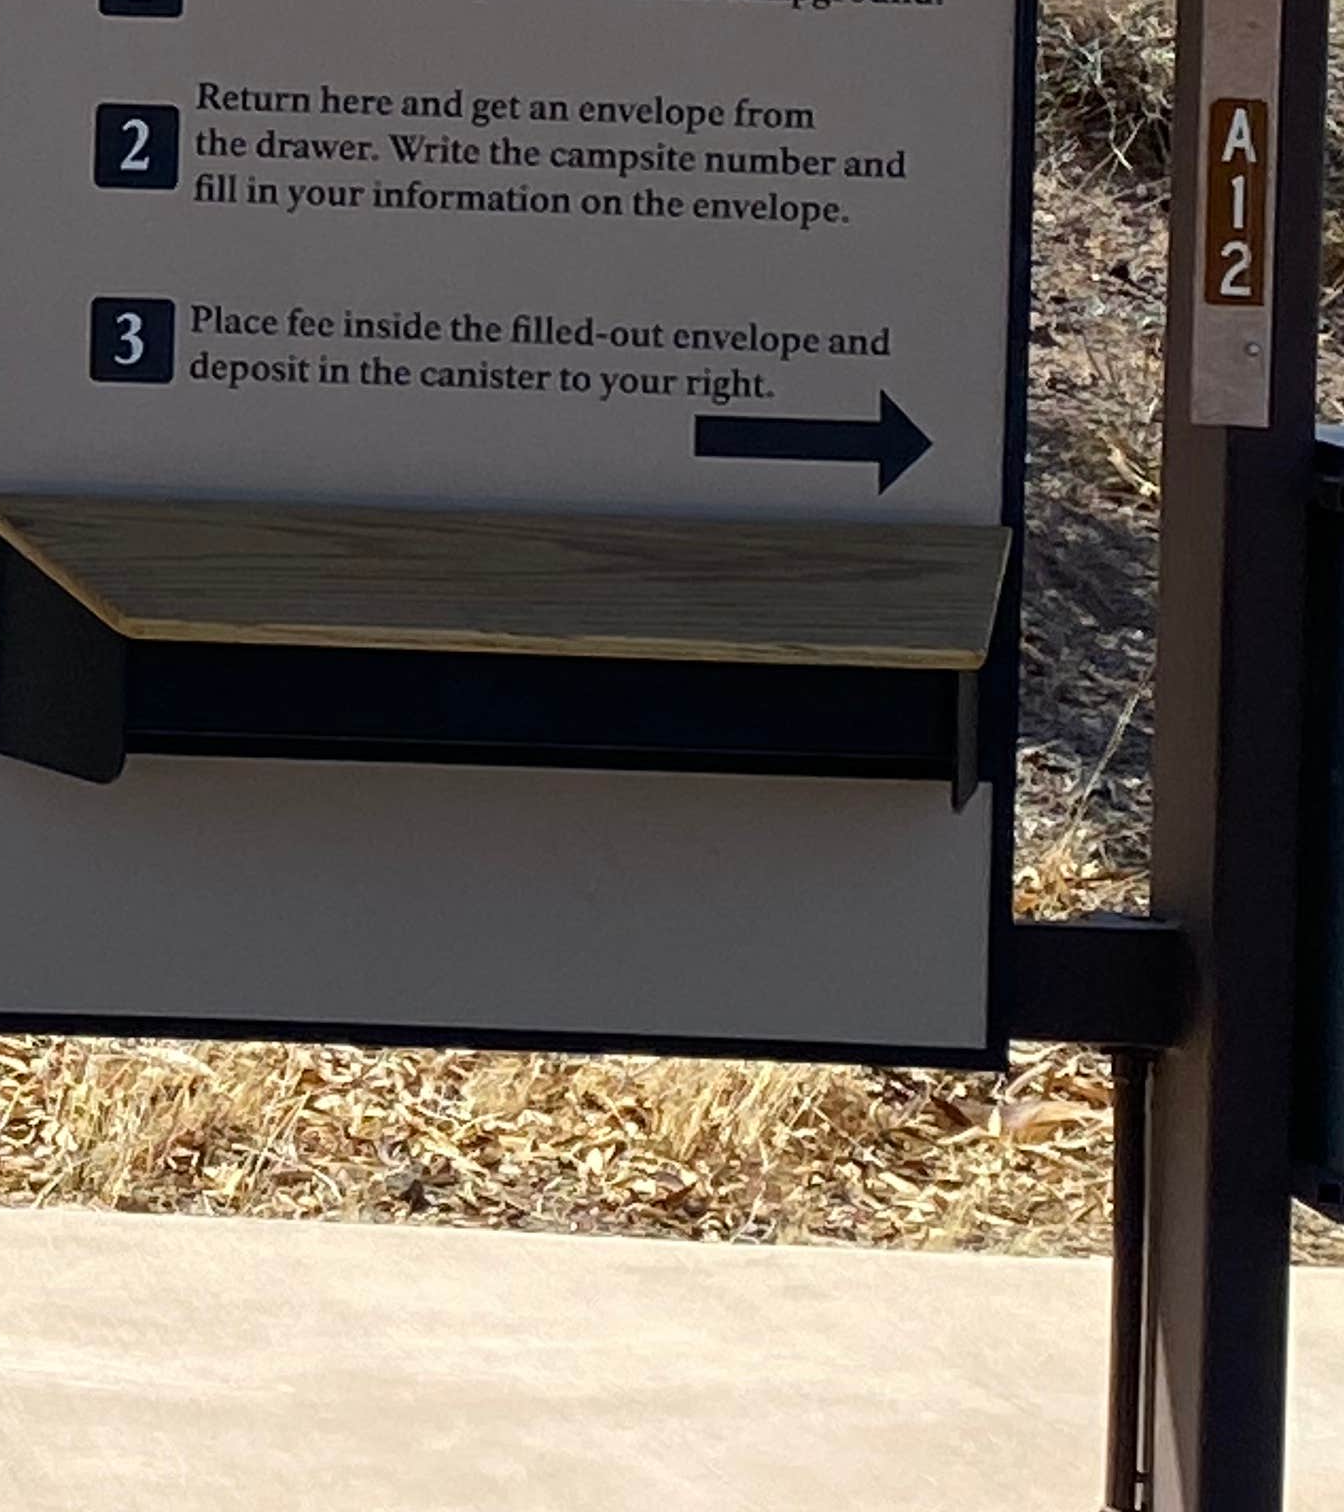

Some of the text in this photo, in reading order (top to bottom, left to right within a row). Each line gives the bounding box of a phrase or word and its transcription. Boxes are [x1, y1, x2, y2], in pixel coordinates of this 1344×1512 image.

[195, 82, 815, 134] Return here and get an envelope from
[120, 118, 906, 179] 2 the drawer. Write the campsite number and
[193, 174, 850, 230] fill in your information on the envelope.
[113, 305, 890, 365] 3 Place fee inside the filled-out envelope and
[189, 351, 776, 405] deposit in the canister to your right.
